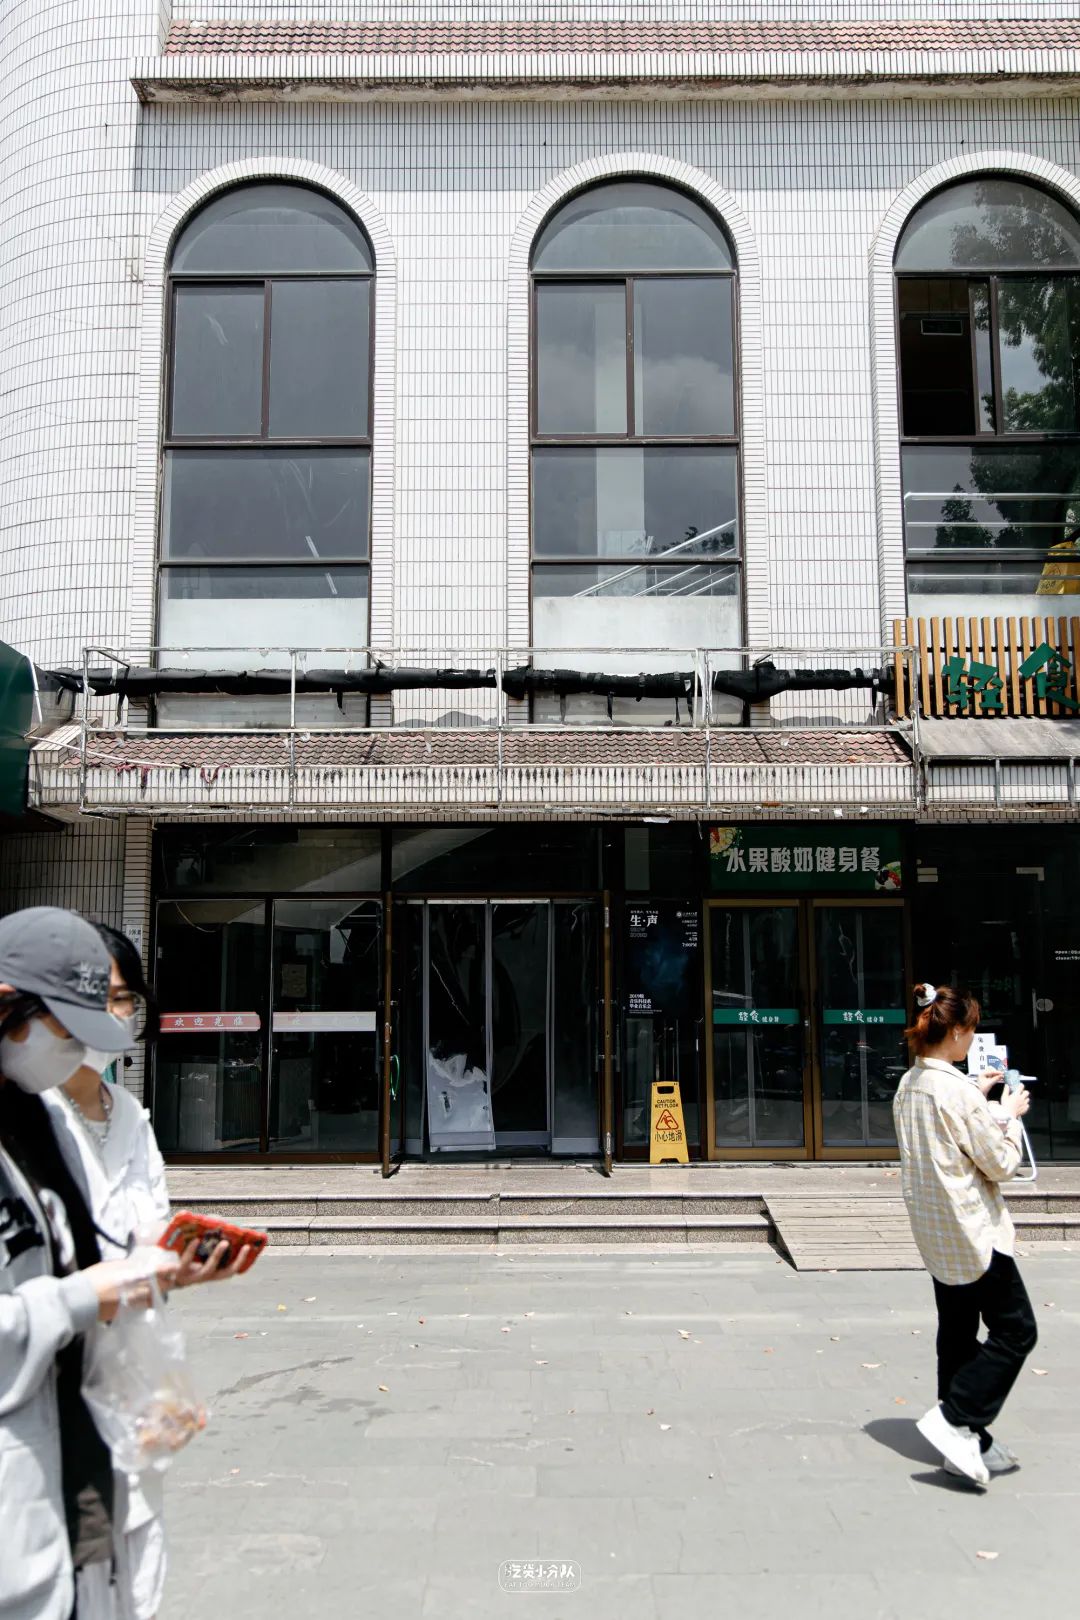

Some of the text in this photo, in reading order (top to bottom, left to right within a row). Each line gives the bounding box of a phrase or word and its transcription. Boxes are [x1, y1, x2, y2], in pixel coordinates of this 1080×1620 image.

[726, 846, 881, 873] 水果酸奶健身餐
[174, 1016, 244, 1027] 欢迎光临
[654, 1130, 683, 1142] 小心地滑
